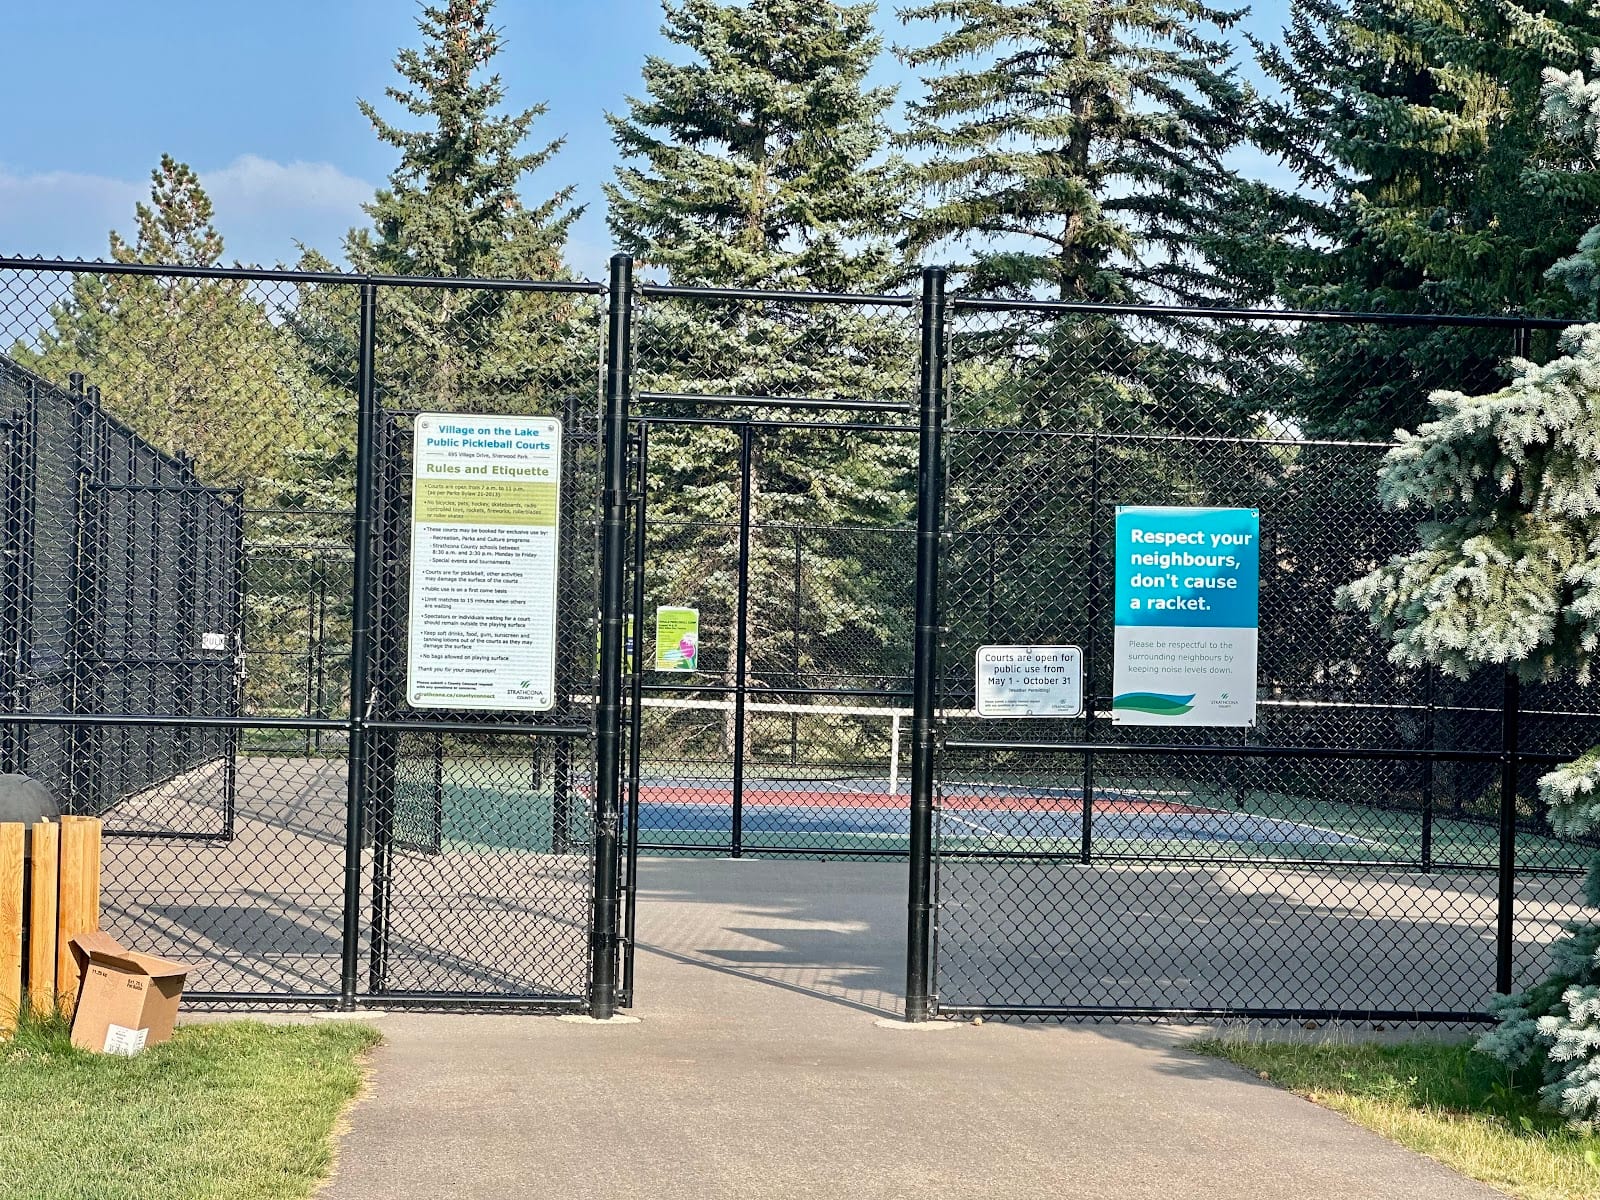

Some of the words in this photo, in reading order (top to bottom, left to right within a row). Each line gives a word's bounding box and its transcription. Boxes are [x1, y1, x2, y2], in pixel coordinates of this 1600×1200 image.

[439, 425, 474, 436] Village
[494, 426, 511, 435] the
[515, 426, 540, 436] Lake
[427, 437, 458, 447] Public
[462, 438, 512, 448] Pickleball
[516, 439, 550, 449] Courts
[426, 463, 460, 473] Rules
[465, 464, 487, 474] and
[492, 465, 549, 477] Etiquette
[1131, 529, 1204, 546] Respect
[1212, 535, 1252, 547] your
[1131, 552, 1241, 568] neighbours,
[1130, 574, 1178, 587] don't
[1184, 578, 1237, 588] cause
[1130, 599, 1140, 608] a
[1148, 596, 1210, 610] racket.
[1129, 640, 1154, 648] Please
[1169, 641, 1207, 650] respectful
[1128, 652, 1175, 662] surrounding
[1178, 653, 1222, 662] neighbours
[1224, 653, 1233, 663] by
[994, 665, 1021, 674] public
[1128, 665, 1159, 674] keeping
[1184, 665, 1207, 673] levels
[988, 677, 1006, 686] May
